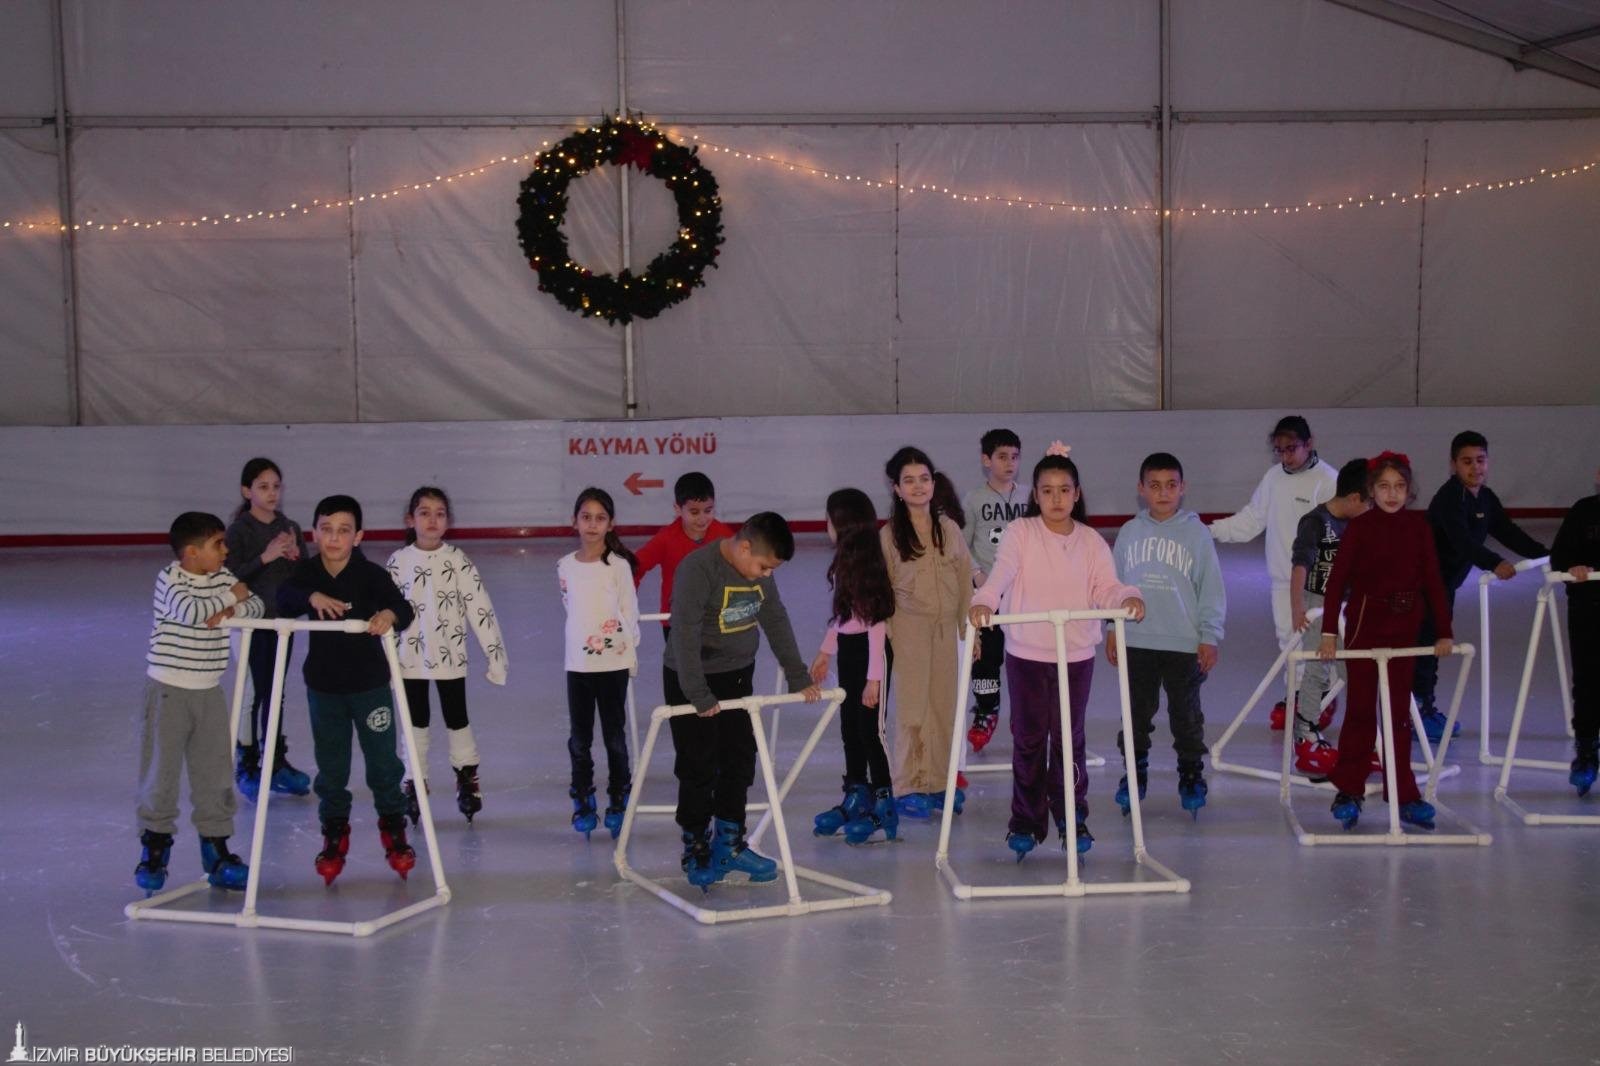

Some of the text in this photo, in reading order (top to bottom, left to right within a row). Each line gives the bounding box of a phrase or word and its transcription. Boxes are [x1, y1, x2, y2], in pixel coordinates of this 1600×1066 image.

[568, 433, 717, 455] KAYMA YÖNÜ
[1124, 537, 1193, 578] ALIFORNI
